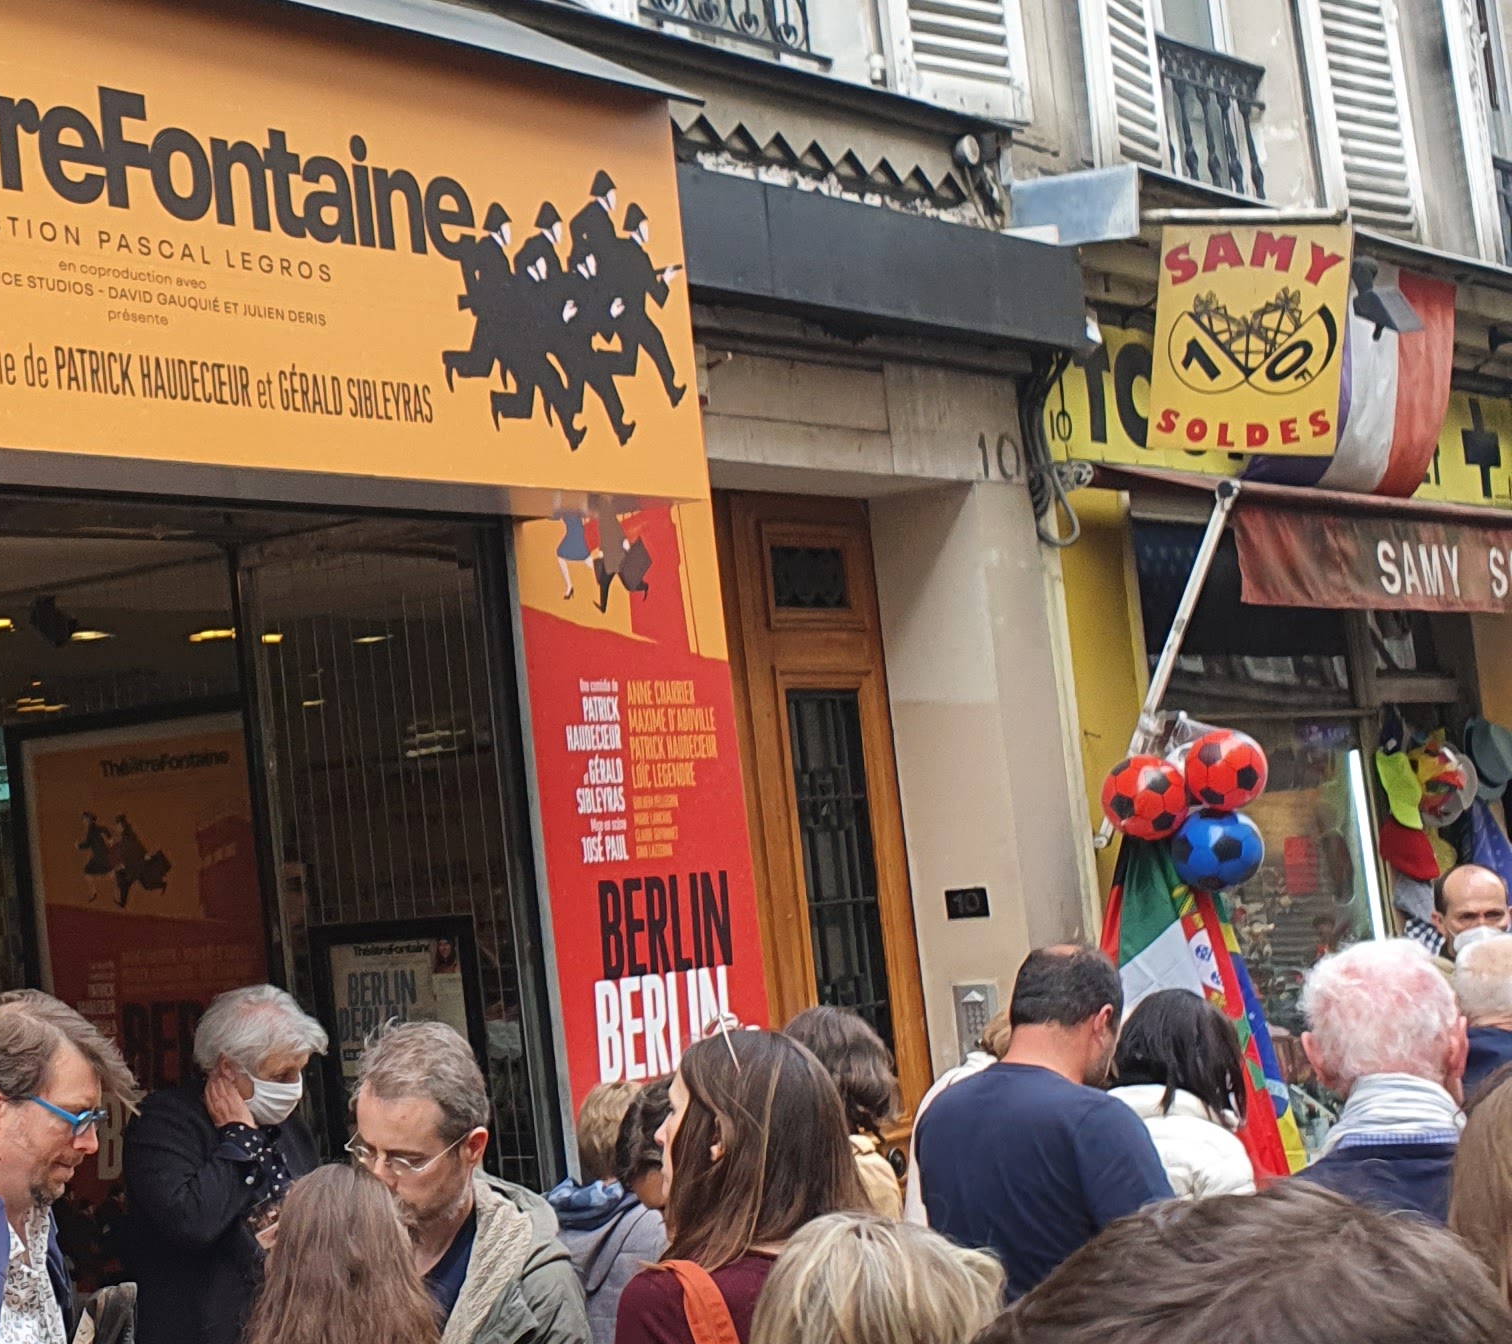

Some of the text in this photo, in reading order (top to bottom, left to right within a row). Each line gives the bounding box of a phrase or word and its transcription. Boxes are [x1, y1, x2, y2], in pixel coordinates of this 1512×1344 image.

[59, 260, 207, 290] en coproduction avec
[99, 231, 211, 264] PASCAL
[226, 249, 332, 283] LEGROS
[1164, 231, 1344, 286] SAMY
[27, 275, 94, 296] STUDIOS
[108, 286, 153, 304] DAVID
[157, 293, 221, 312] GAUQUIÉ
[224, 301, 239, 314] ET
[243, 304, 285, 321] JULIEN
[288, 310, 327, 326] DERIS
[107, 308, 169, 325] présente
[23, 342, 49, 389] de
[54, 346, 135, 396] PATRICK
[138, 355, 252, 408] HAUDECŒUR
[256, 374, 275, 410] et
[278, 363, 343, 416] GÉRALD
[346, 377, 433, 424] SIBLEYRAS
[1156, 408, 1330, 449] SOLDES
[1377, 540, 1460, 597] SAMY
[582, 695, 620, 723] PATRICK
[627, 680, 653, 705] ANNE
[588, 754, 624, 785] GÉRALD
[576, 786, 626, 814] SIBLEYRAS
[581, 831, 605, 864] JOSÉ
[605, 833, 629, 862] PAUL
[598, 870, 733, 982] BERLIN
[347, 969, 417, 1007] BERLIN
